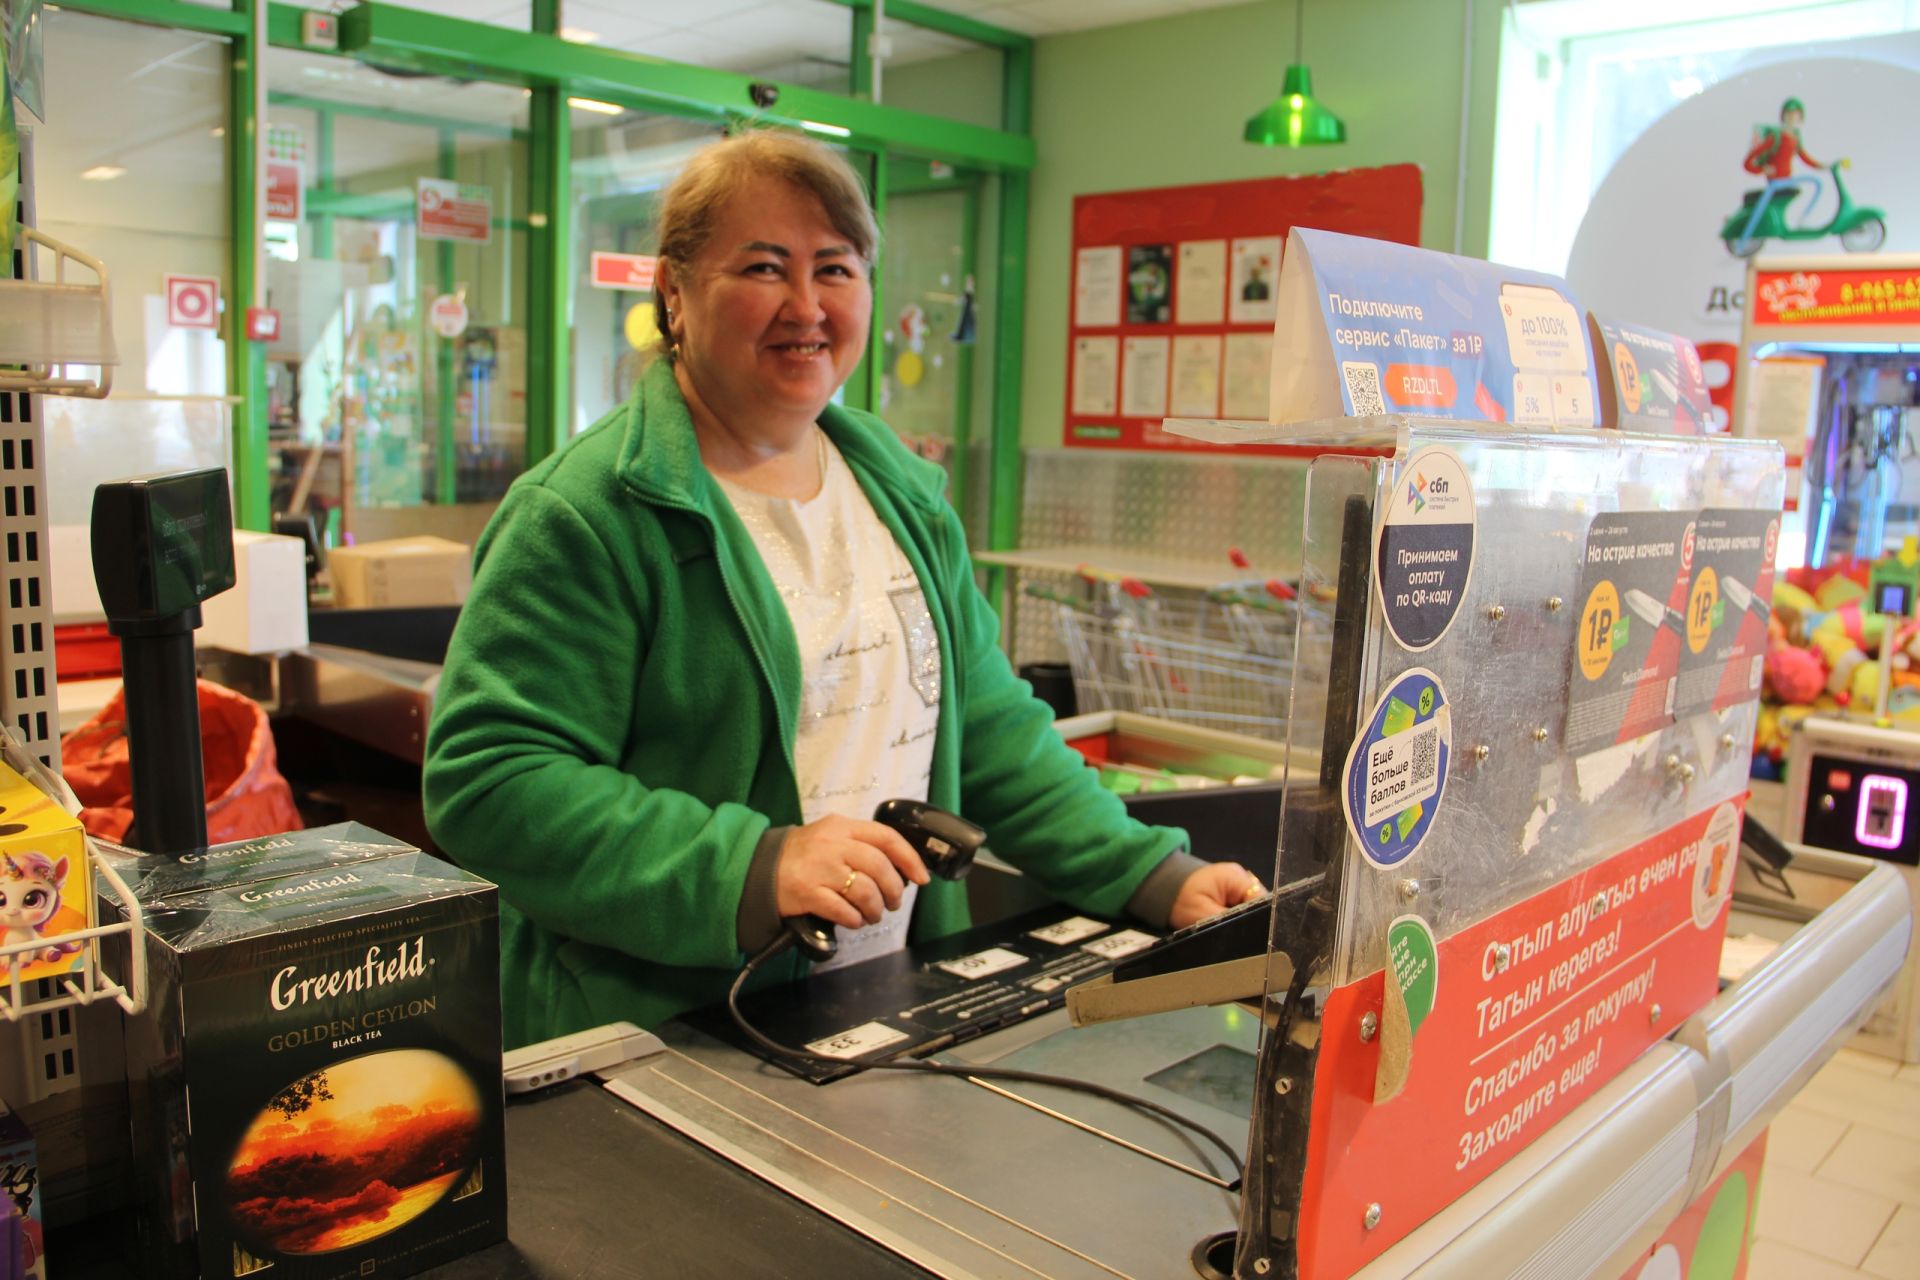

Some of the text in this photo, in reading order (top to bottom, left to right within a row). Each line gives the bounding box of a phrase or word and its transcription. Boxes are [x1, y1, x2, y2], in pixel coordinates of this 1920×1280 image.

[1329, 294, 1423, 320] Подключите
[1521, 316, 1568, 336] до 100%
[1336, 328, 1390, 351] сервис
[1394, 329, 1447, 350] «Пакет»
[1452, 337, 1466, 353] за
[1403, 377, 1443, 395] RZDLTL
[1572, 399, 1579, 414] 5
[1429, 477, 1449, 494] сбп
[1588, 541, 1675, 564] На острие качества
[1696, 536, 1761, 553] На острие качества
[1397, 549, 1459, 569] Принимаем
[1408, 569, 1445, 586] оплату
[1396, 589, 1453, 607] по QR-коду
[1372, 746, 1394, 768] Ещё
[1372, 760, 1409, 786] больше
[1370, 779, 1406, 805] баллов
[179, 838, 296, 865] Greenfield
[239, 873, 363, 903] Greenfield
[1640, 857, 1676, 893] өчен
[279, 915, 420, 951] FINELY SELECTED SPECIALITY TEA
[270, 935, 427, 1011] Greenfield
[1401, 958, 1427, 994] кассе
[1477, 919, 1622, 1038] Тагын керегез!
[268, 996, 437, 1052] GOLDEN CEYLON
[1464, 958, 1656, 1116] Спасибо за покупку!
[332, 1029, 382, 1049] BLACK TEA
[1456, 1036, 1602, 1171] Заходите еще!
